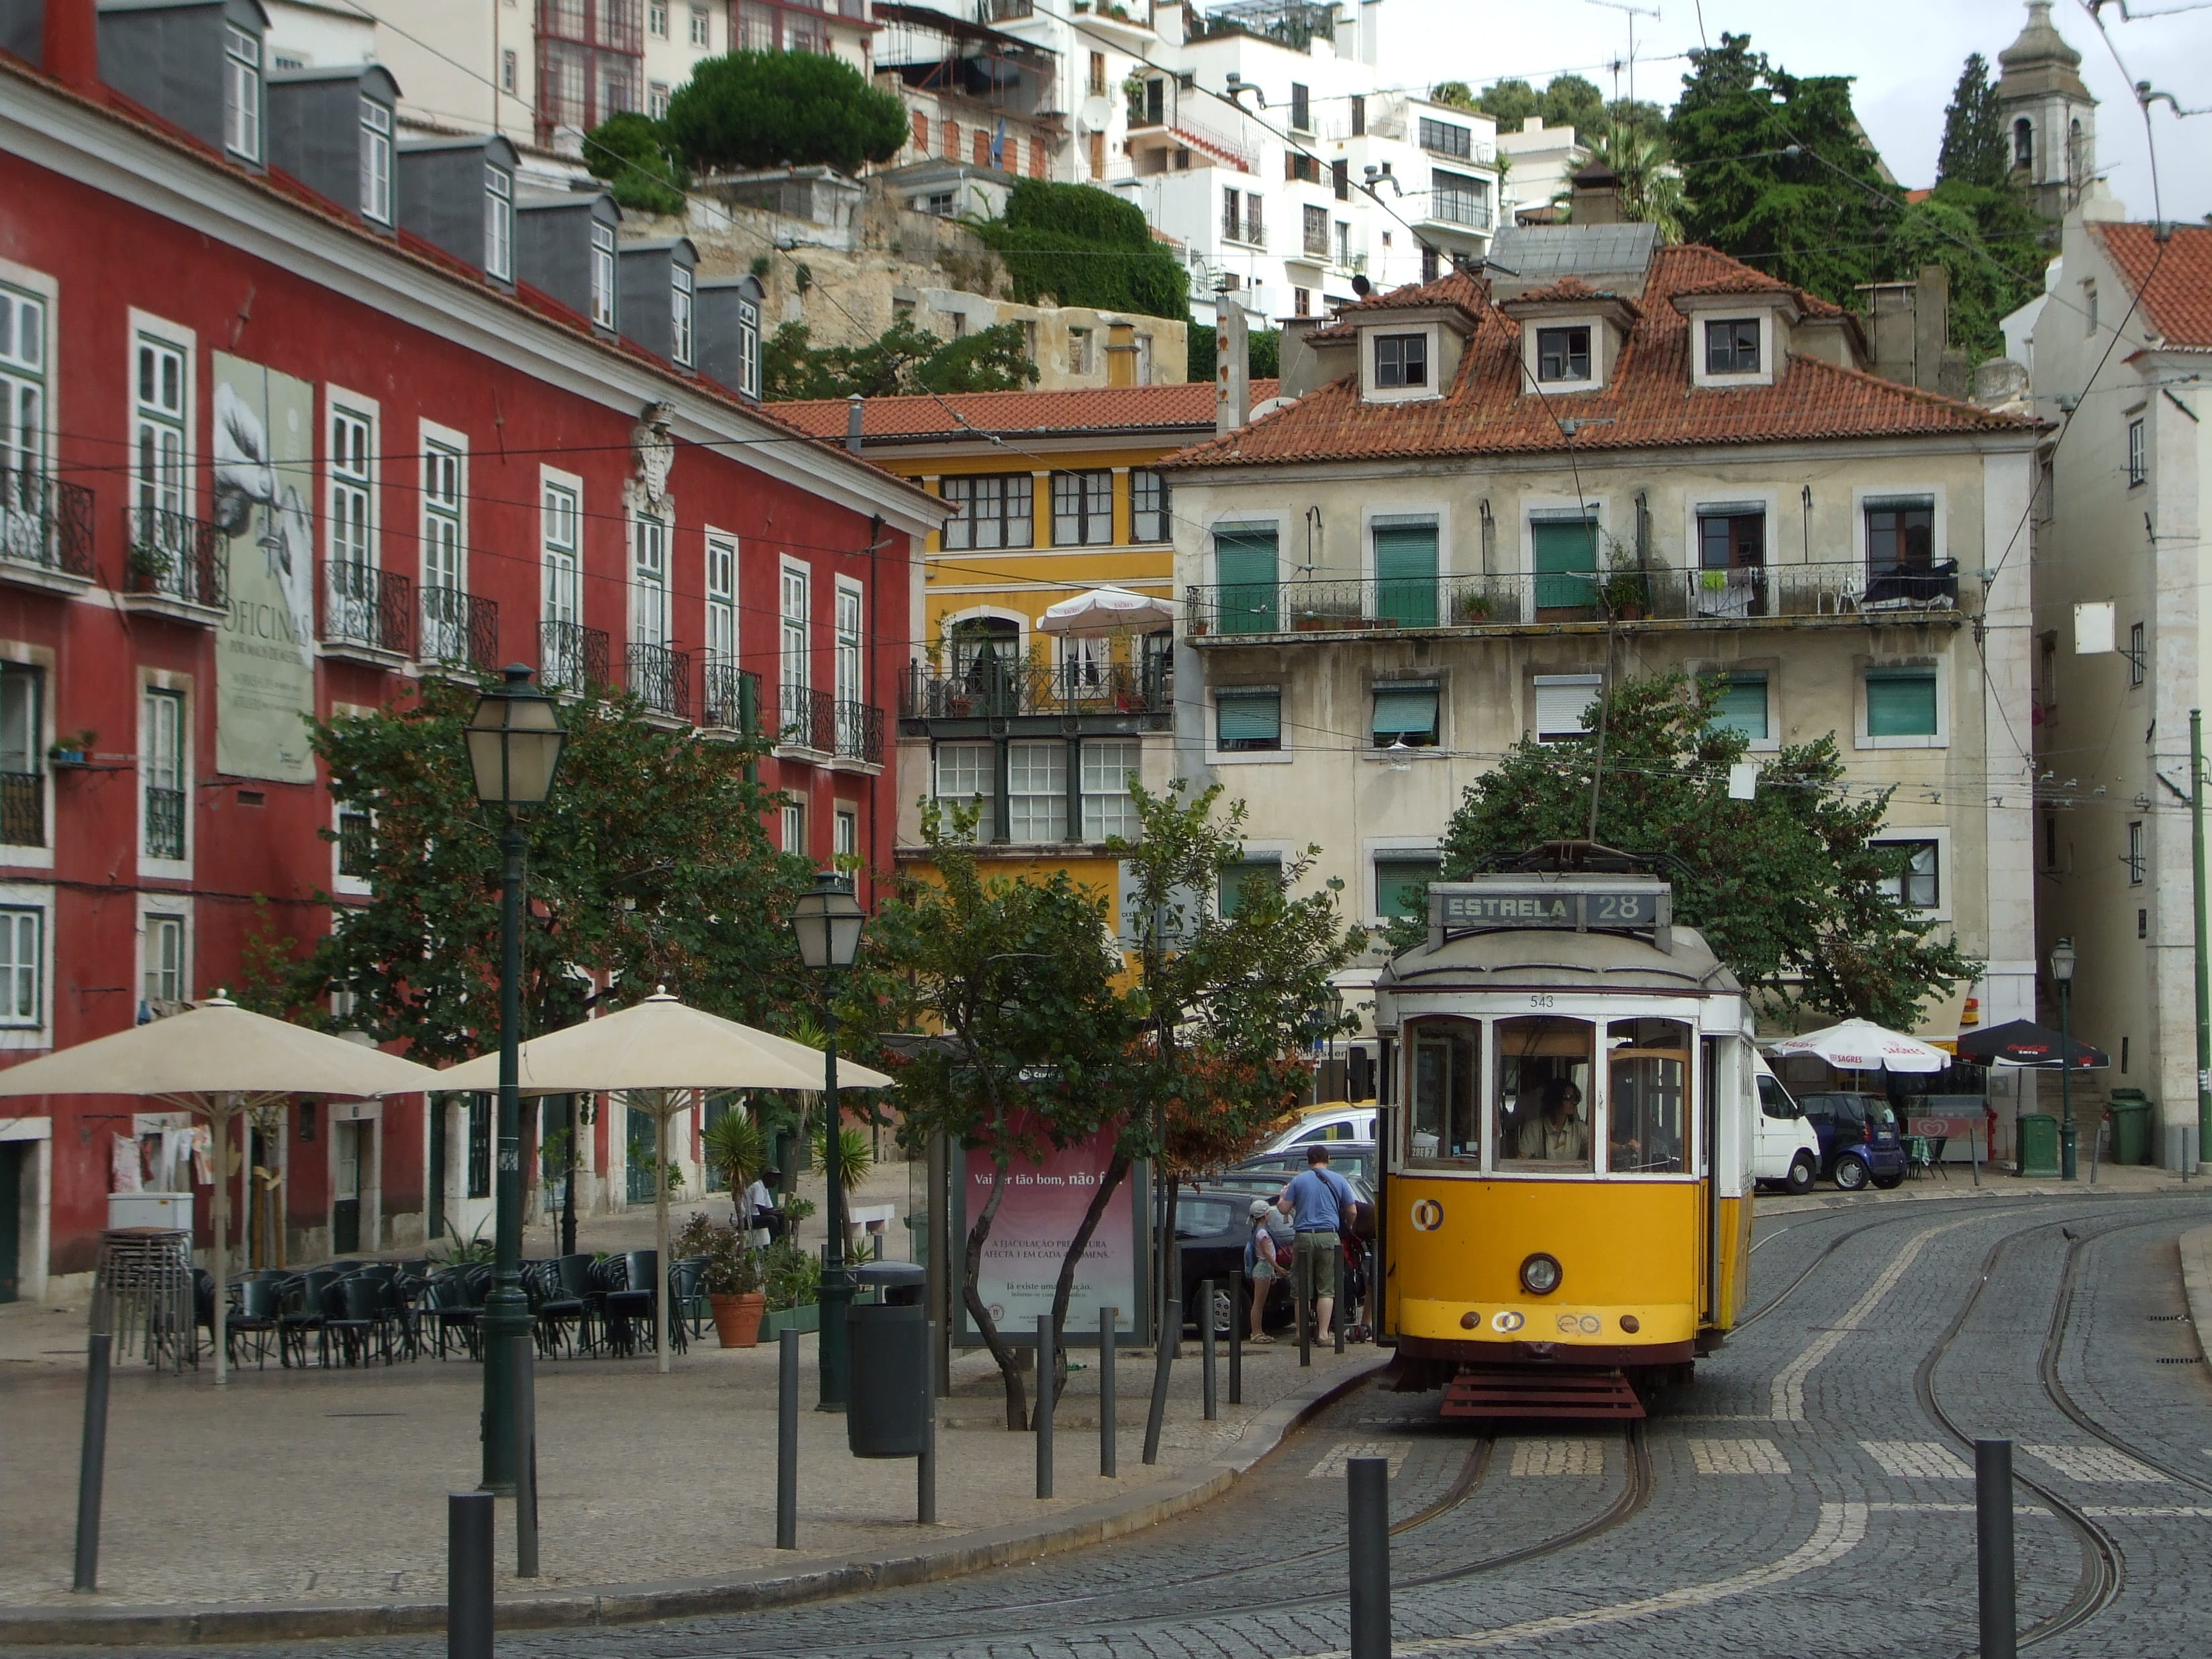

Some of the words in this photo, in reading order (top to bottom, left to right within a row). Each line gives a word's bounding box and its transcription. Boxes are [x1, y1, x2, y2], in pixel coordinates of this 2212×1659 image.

[223, 597, 309, 647] OFICINAS
[1448, 899, 1568, 918] ESTRELA
[1599, 895, 1640, 919] 28
[1530, 995, 1554, 1007] 543
[1838, 1054, 1862, 1064] SAGRES
[1428, 1148, 1434, 1156] 7
[974, 1173, 992, 1185] Vai
[1015, 1174, 1034, 1185] tão
[1036, 1173, 1066, 1187] bom,
[1068, 1172, 1095, 1185] não
[1000, 1239, 1054, 1249] EJACULAÇÃO
[1007, 1281, 1014, 1290] Já
